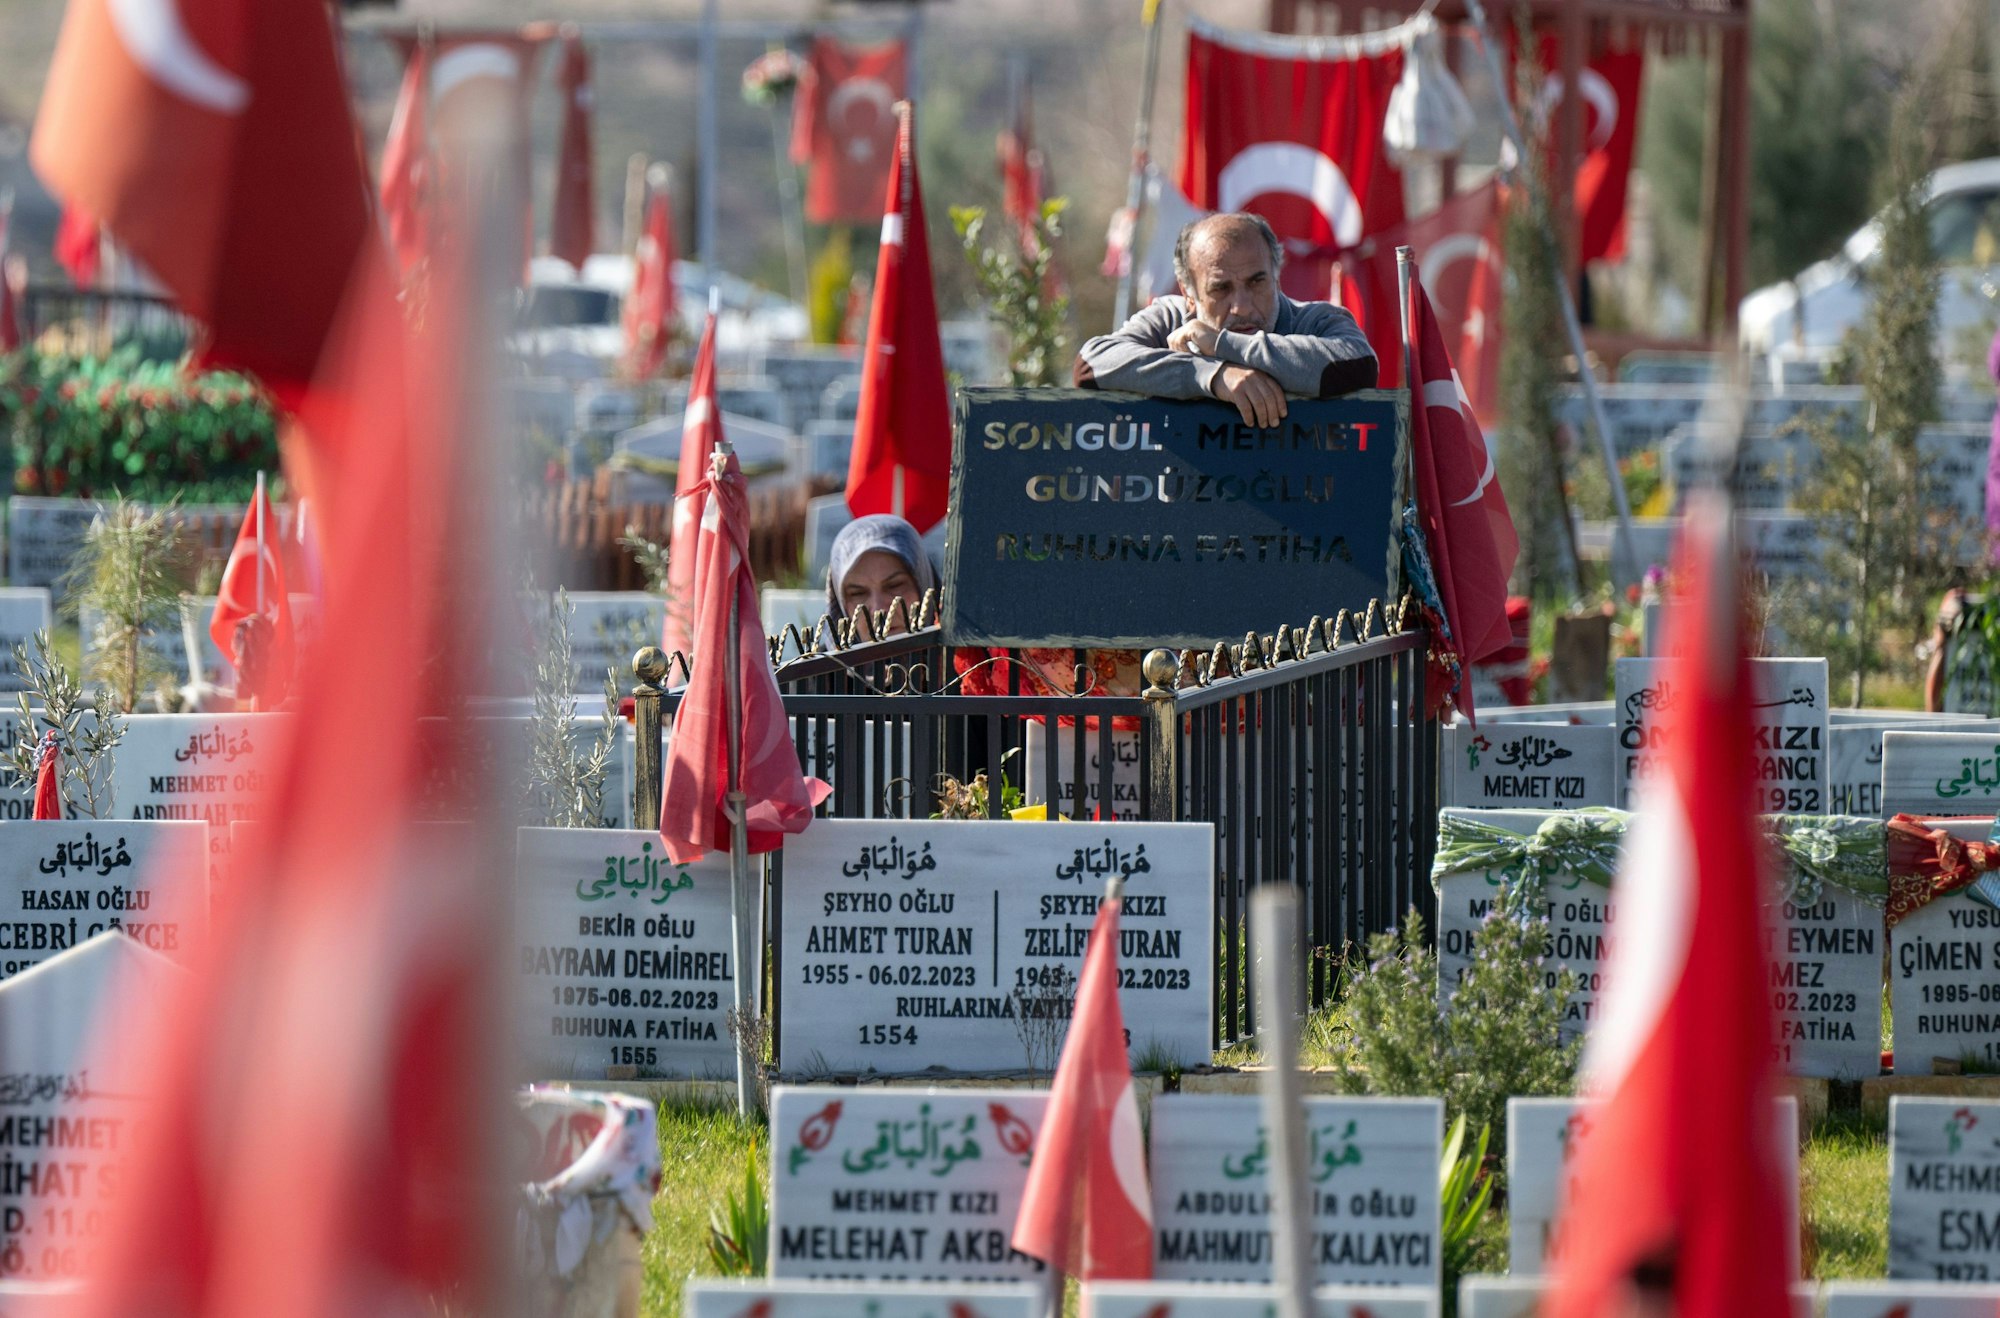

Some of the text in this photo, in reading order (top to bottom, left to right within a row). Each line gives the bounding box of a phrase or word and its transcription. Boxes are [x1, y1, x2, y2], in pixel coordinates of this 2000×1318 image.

[983, 414, 1163, 451] SONGÜL
[1197, 421, 1378, 451] MEHMET
[1025, 466, 1335, 504] GÜNDÜZOĞLU
[995, 526, 1354, 563] RUHUNA FATİHA
[150, 775, 228, 794] MEHMET
[1484, 775, 1585, 799] MEMET KIZI
[1757, 788, 1820, 812] 1952
[21, 886, 151, 911] HASAN OĞLU
[823, 887, 955, 918] ŞEYHO OĞLU
[1119, 895, 1167, 917] KIZI
[1564, 898, 1617, 923] OĞLU
[578, 913, 695, 939] BEKİR OĞLU
[805, 925, 973, 956] AHMET TURAN
[1024, 922, 1182, 959] ZELİF URAN
[1787, 927, 1874, 954] EYMEN
[522, 946, 616, 978] BAYRAM
[1900, 935, 1982, 979] ÇİMEN
[802, 964, 849, 985] 1955
[868, 965, 976, 987] 06.02.2023
[552, 986, 719, 1011] 1975-06.02.2023
[895, 996, 1015, 1019] RUHLARINA
[551, 1016, 718, 1041] RUHUNA FATİHA
[859, 1024, 918, 1045] 1554
[1781, 1016, 1857, 1042] FATİHA
[610, 1046, 657, 1065] 1555
[832, 1189, 999, 1215] MEHMET KIZI
[1350, 1189, 1416, 1218] OĞLU
[780, 1226, 929, 1262] MELEHAT
